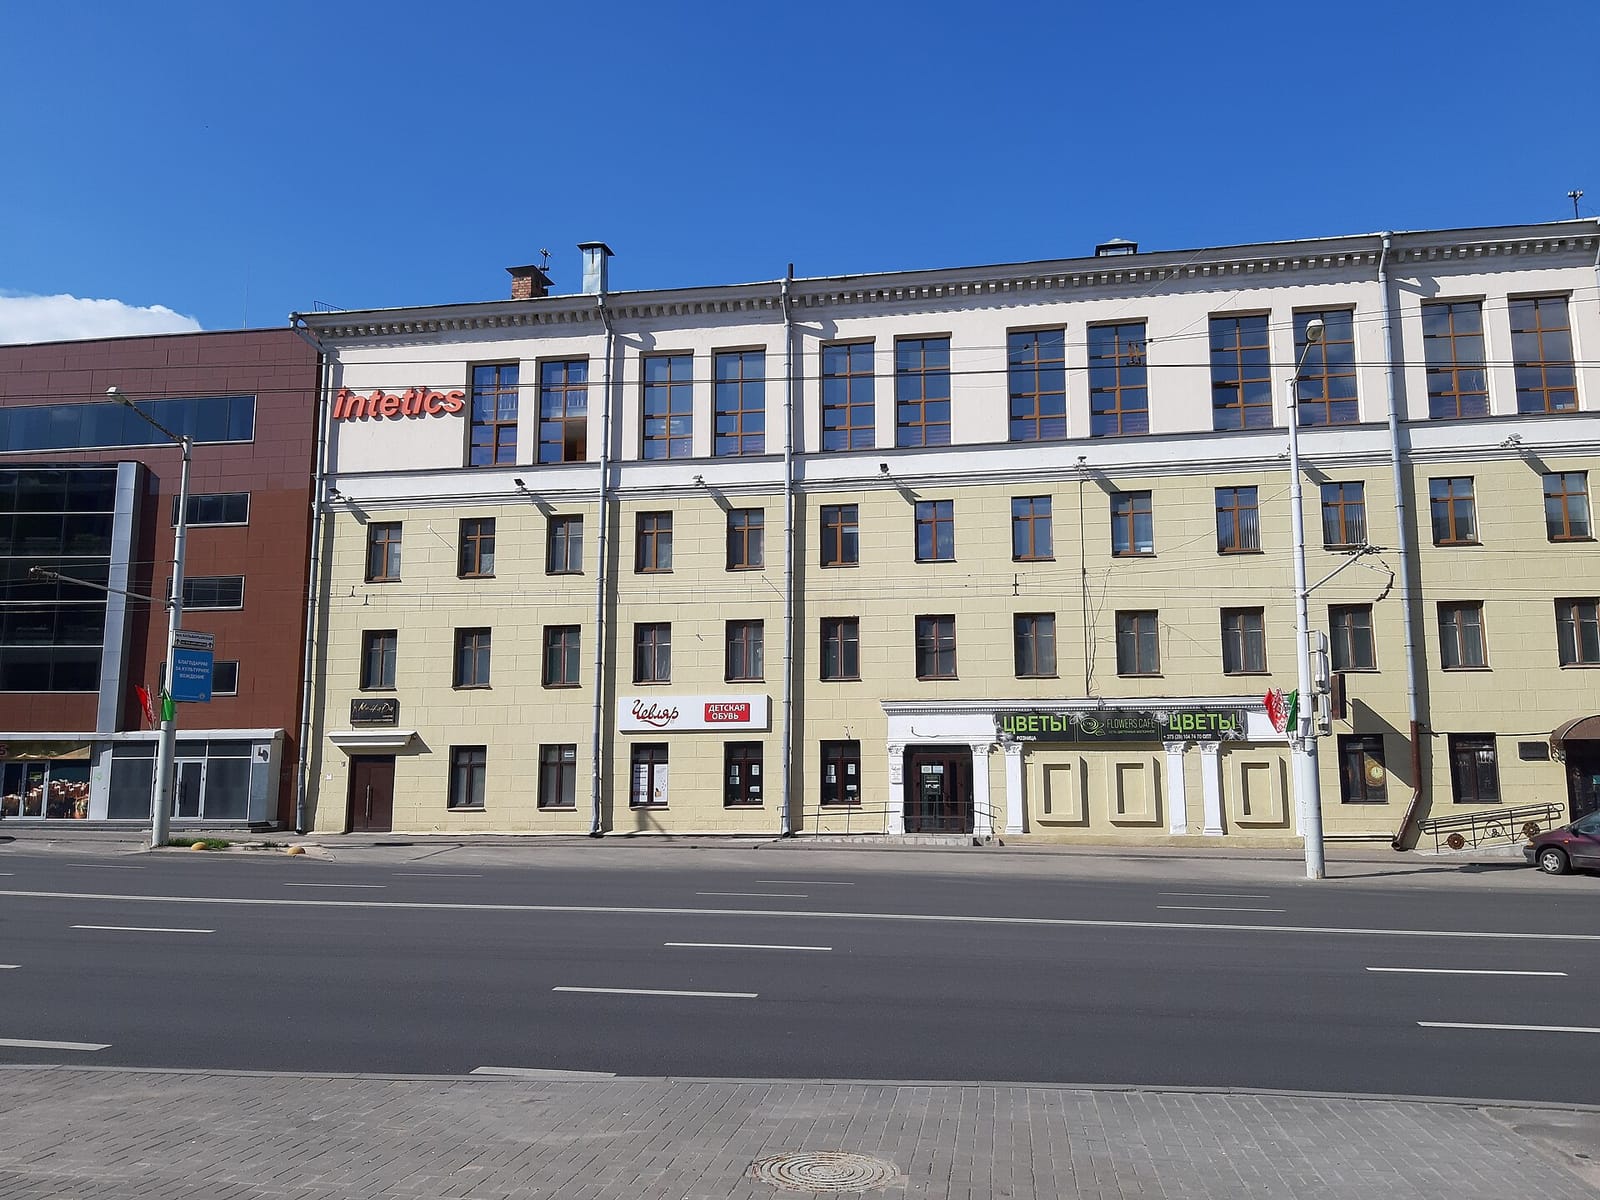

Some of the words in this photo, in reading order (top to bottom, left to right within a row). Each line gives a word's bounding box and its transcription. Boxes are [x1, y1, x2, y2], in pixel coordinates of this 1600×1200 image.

[333, 386, 465, 420] intetics
[631, 699, 679, 727] Чевляр
[708, 704, 746, 713] ДЕТСКАЯ
[711, 711, 739, 720] ОБУВЬ
[1003, 715, 1067, 735] ЦВЕТЫ
[1106, 718, 1138, 729] FLOWERS
[1138, 718, 1156, 729] CAFE
[1169, 713, 1236, 733] ЦВЕТЫ
